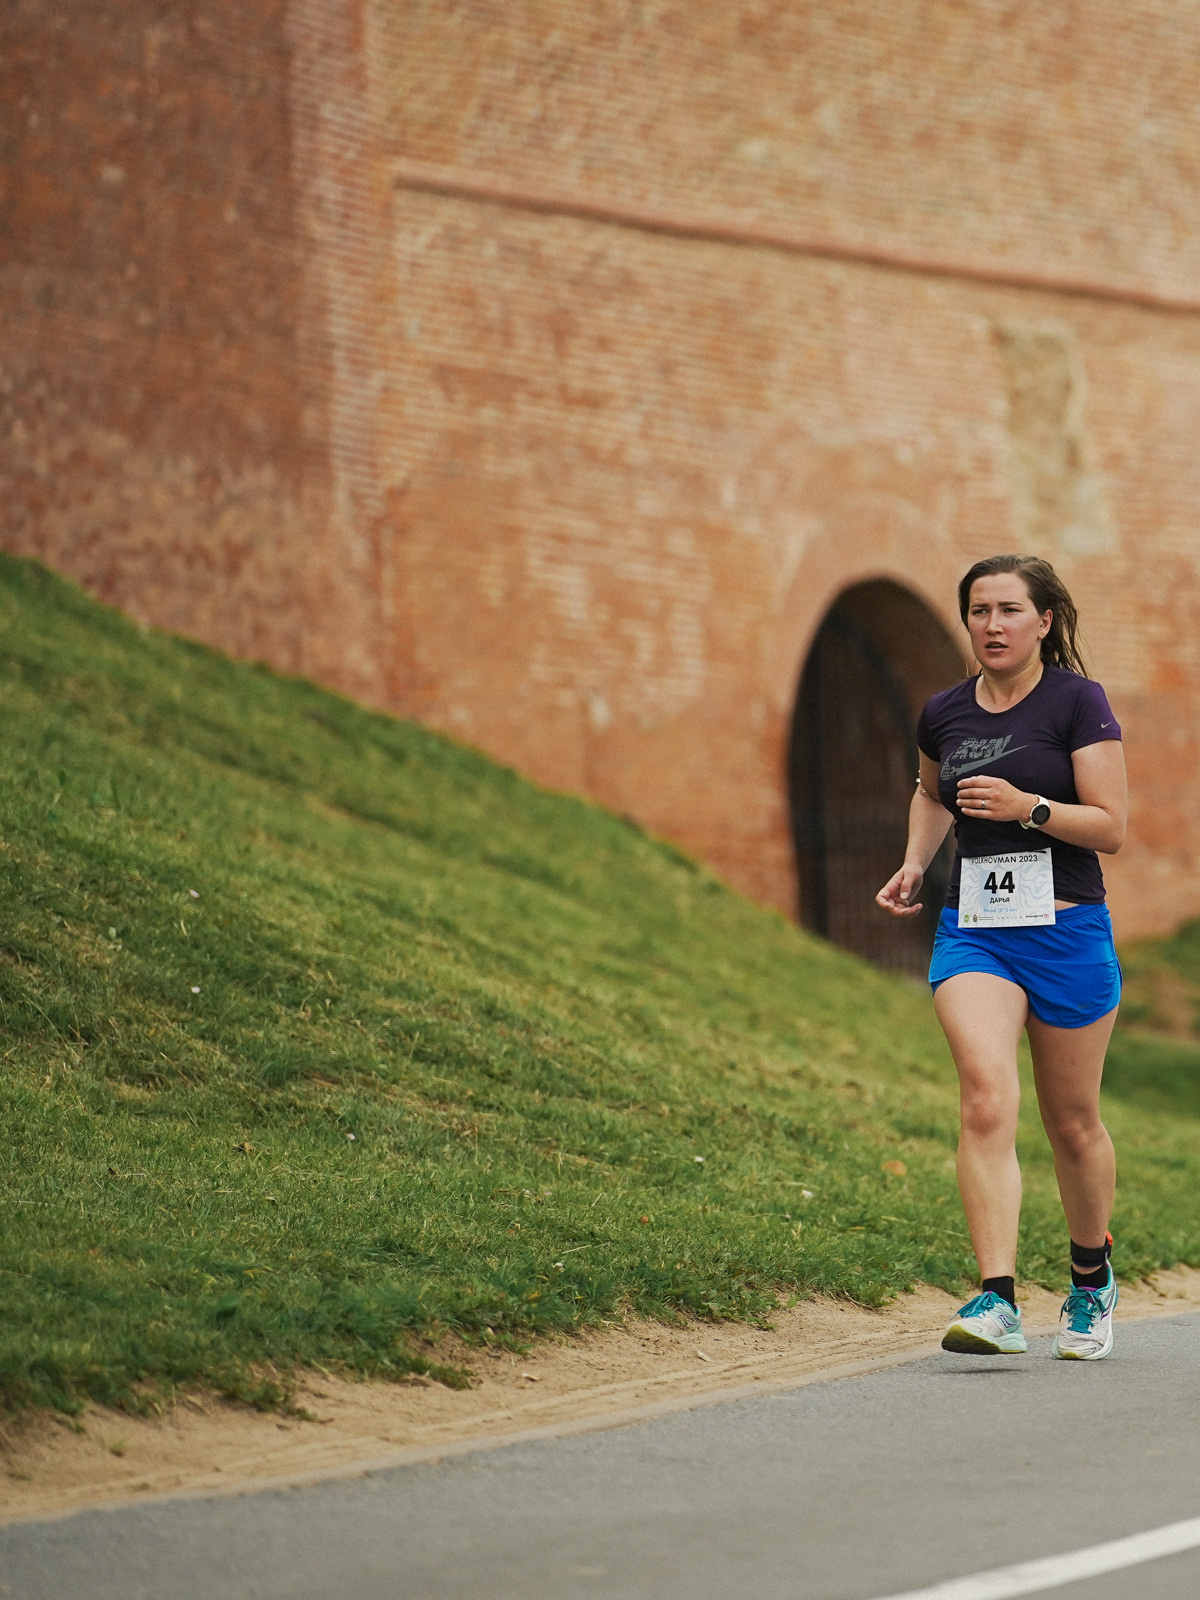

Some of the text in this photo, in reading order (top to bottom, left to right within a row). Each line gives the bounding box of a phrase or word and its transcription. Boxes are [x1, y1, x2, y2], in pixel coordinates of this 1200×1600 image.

[951, 734, 1012, 759] RUN
[1019, 854, 1038, 863] 2023
[983, 871, 1015, 894] 44
